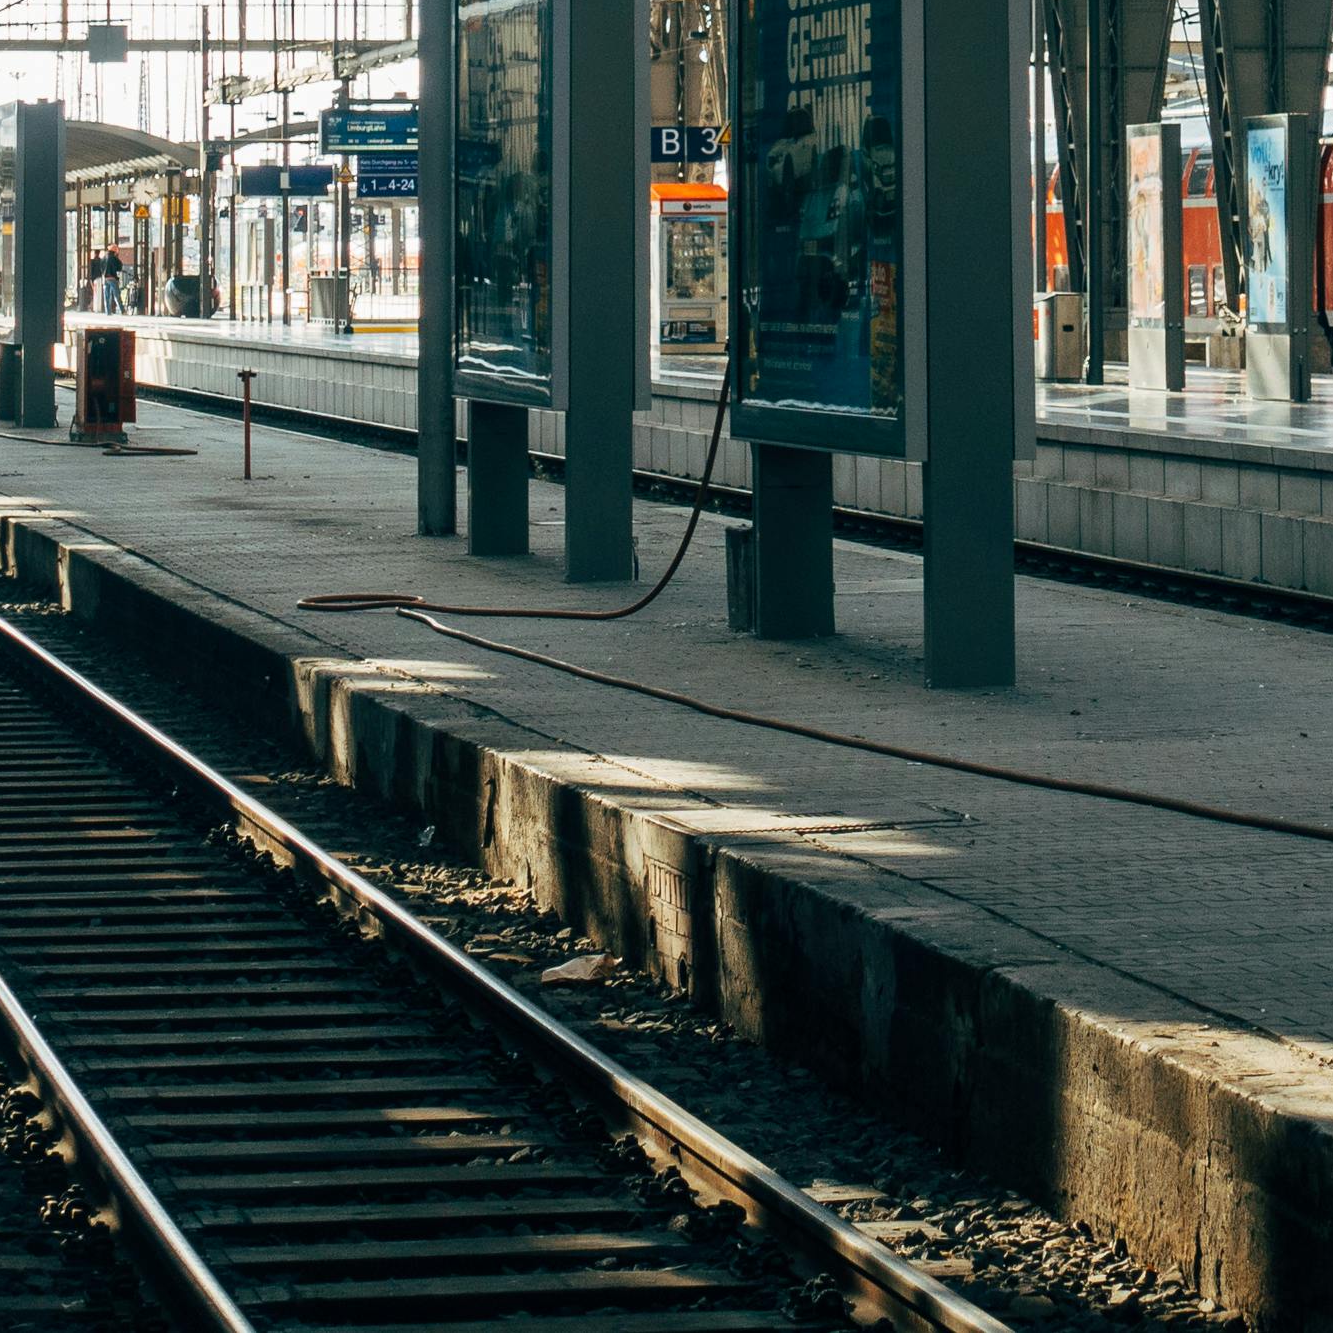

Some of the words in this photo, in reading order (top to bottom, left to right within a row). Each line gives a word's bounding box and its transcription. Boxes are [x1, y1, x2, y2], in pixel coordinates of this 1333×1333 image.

[787, 3, 872, 84] GEWINNE
[662, 128, 680, 155] B
[701, 128, 717, 155] 3
[787, 81, 872, 154] WINNE
[371, 178, 377, 191] 1
[388, 178, 415, 191] 4-24
